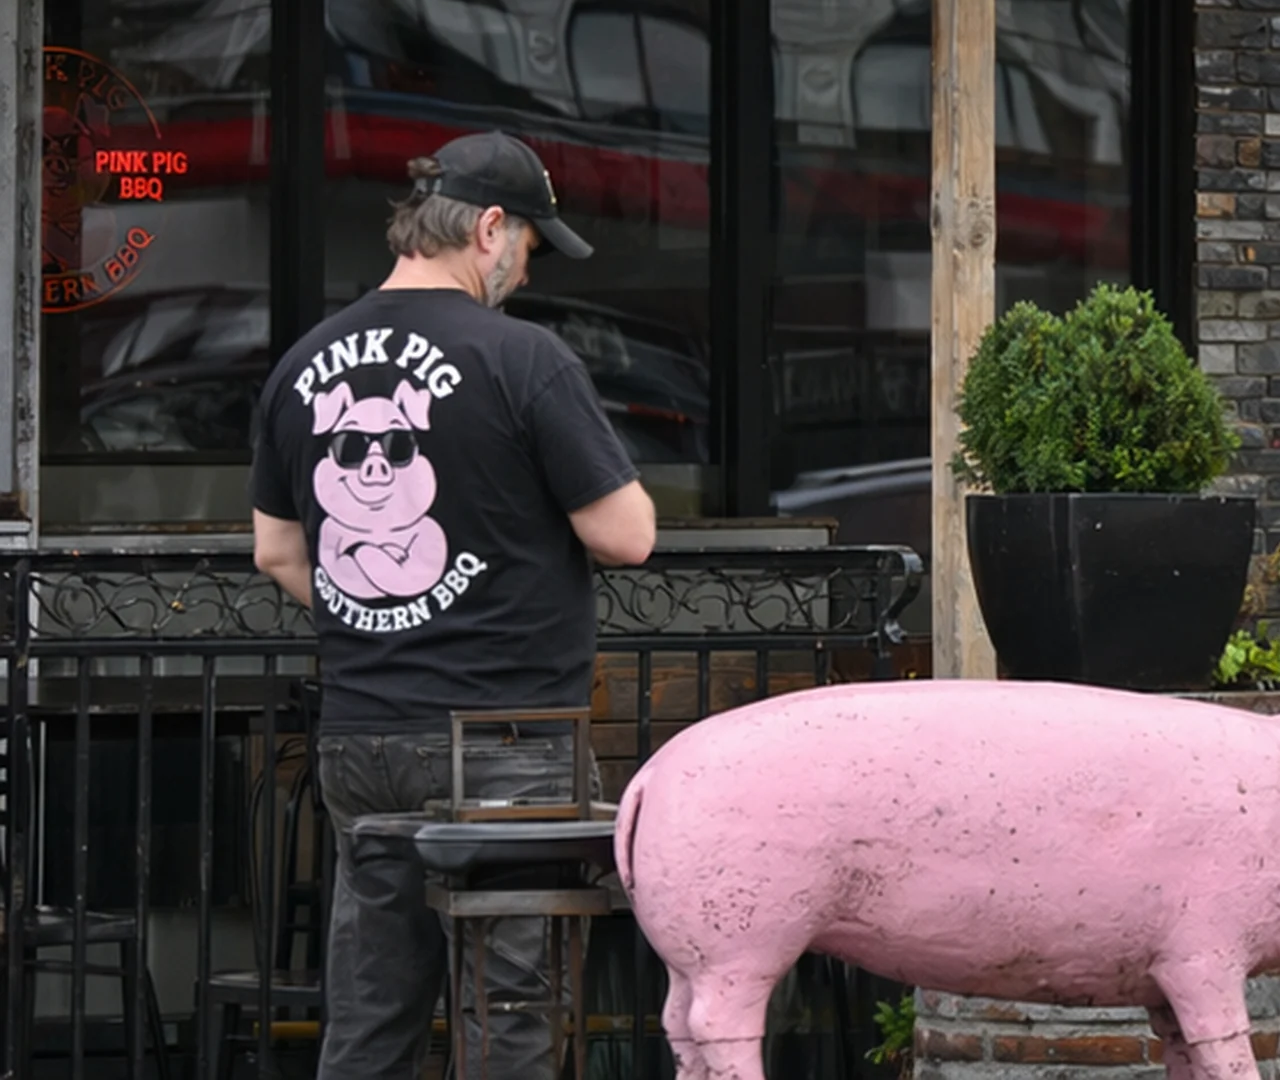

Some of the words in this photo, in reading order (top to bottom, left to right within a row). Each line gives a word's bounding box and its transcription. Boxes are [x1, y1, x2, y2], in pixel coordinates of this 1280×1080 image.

[95, 151, 148, 173] PINK
[152, 151, 188, 174] PIG
[119, 177, 164, 201] BBQ
[104, 226, 156, 284] BBQ
[293, 328, 394, 406] PINK
[396, 332, 463, 400] PIG
[432, 551, 487, 610] BBQ
